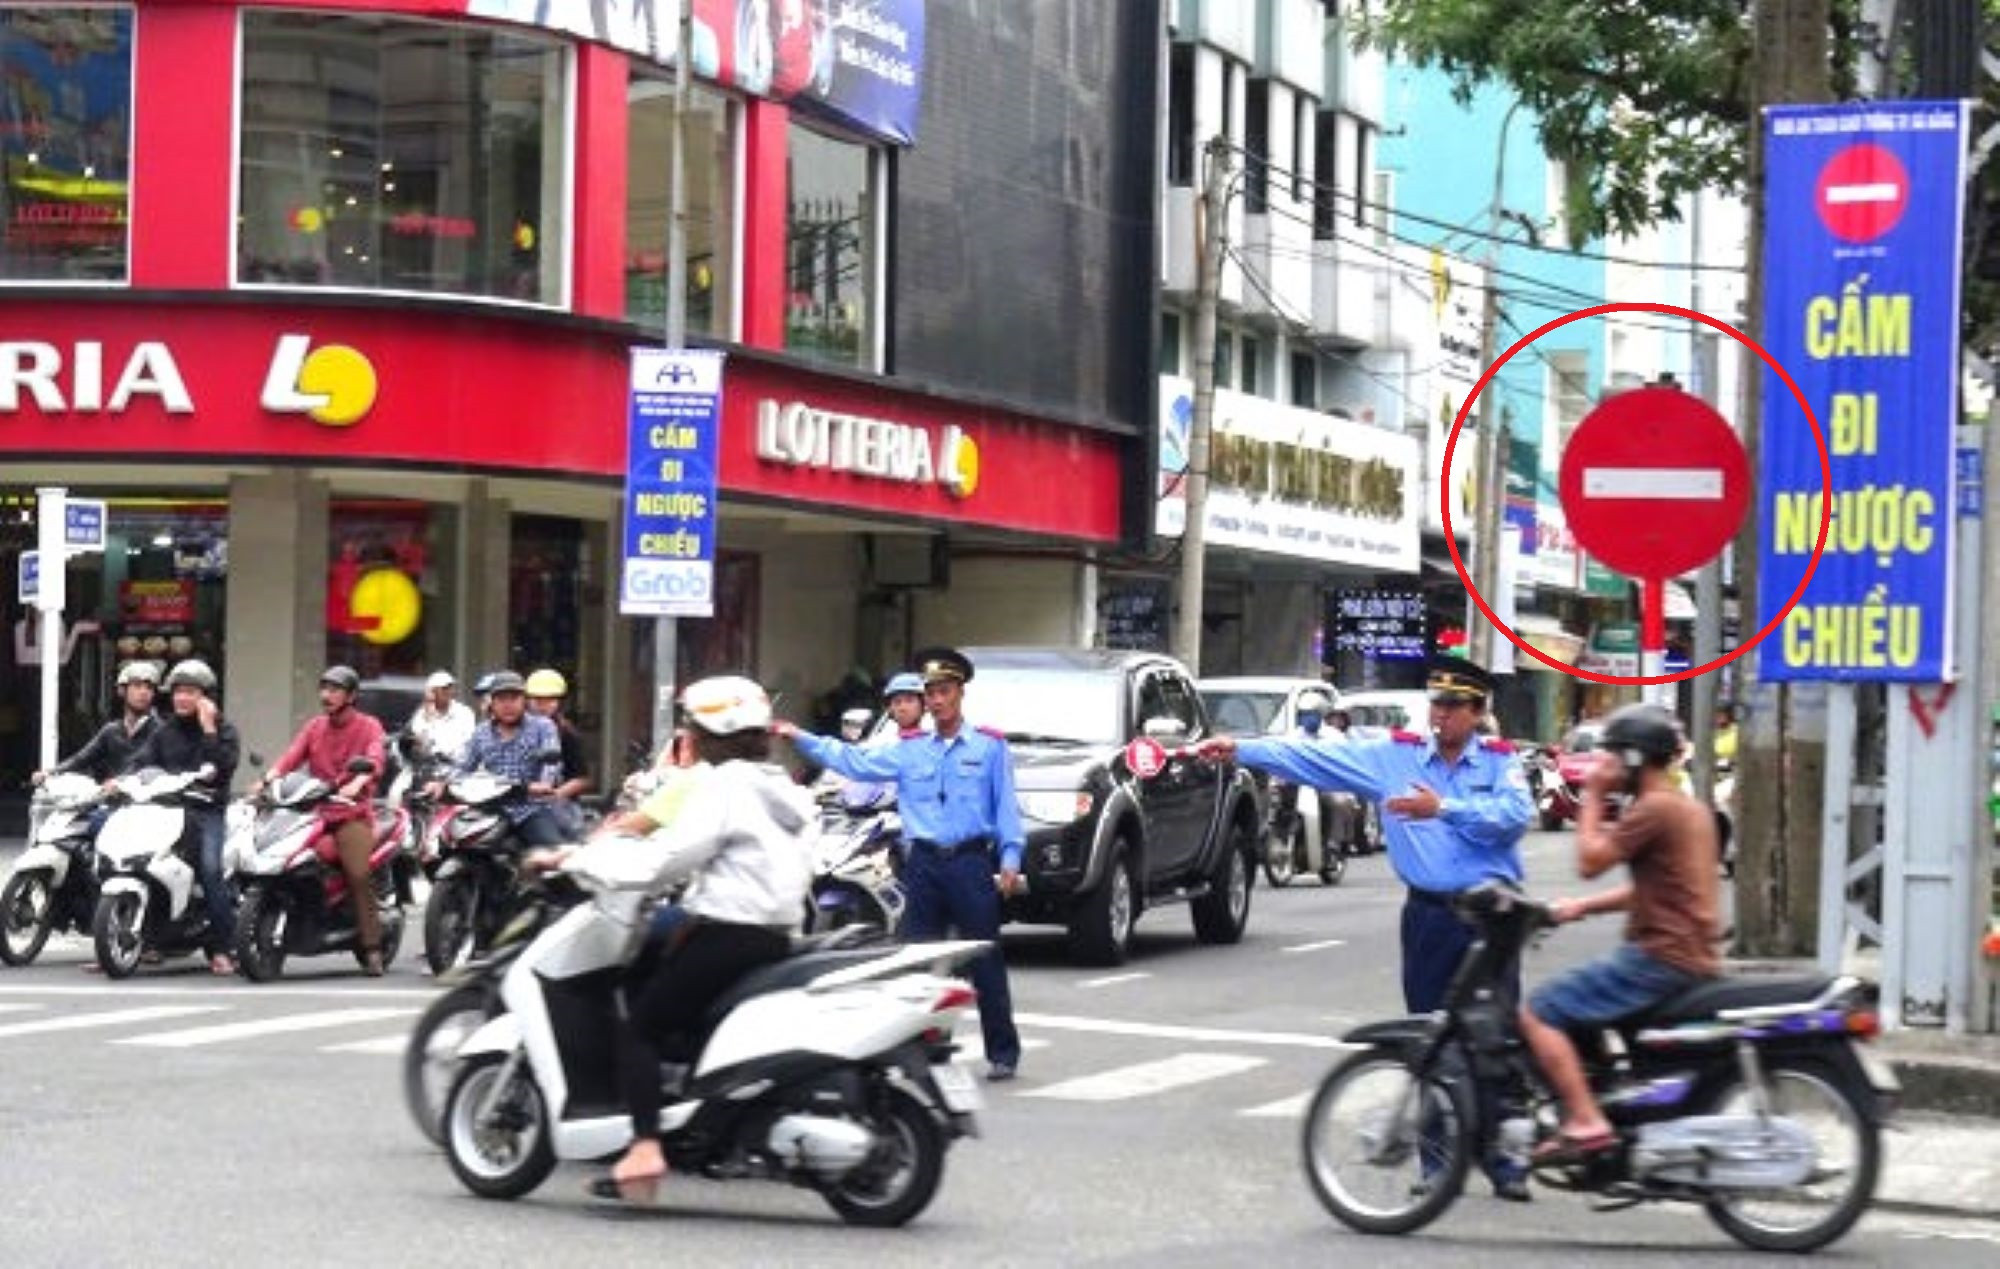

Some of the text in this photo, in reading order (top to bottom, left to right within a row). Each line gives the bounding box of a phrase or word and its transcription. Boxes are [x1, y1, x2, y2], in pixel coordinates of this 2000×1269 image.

[1806, 272, 1911, 360] CẤM
[649, 418, 697, 449] CẤM
[757, 398, 934, 482] LOTTERIA
[1830, 391, 1878, 456] ĐI
[660, 459, 683, 482] ĐI
[1774, 483, 1934, 568] NGƯỢC
[630, 567, 707, 597] Grab
[1784, 583, 1921, 667] CHIỀU
